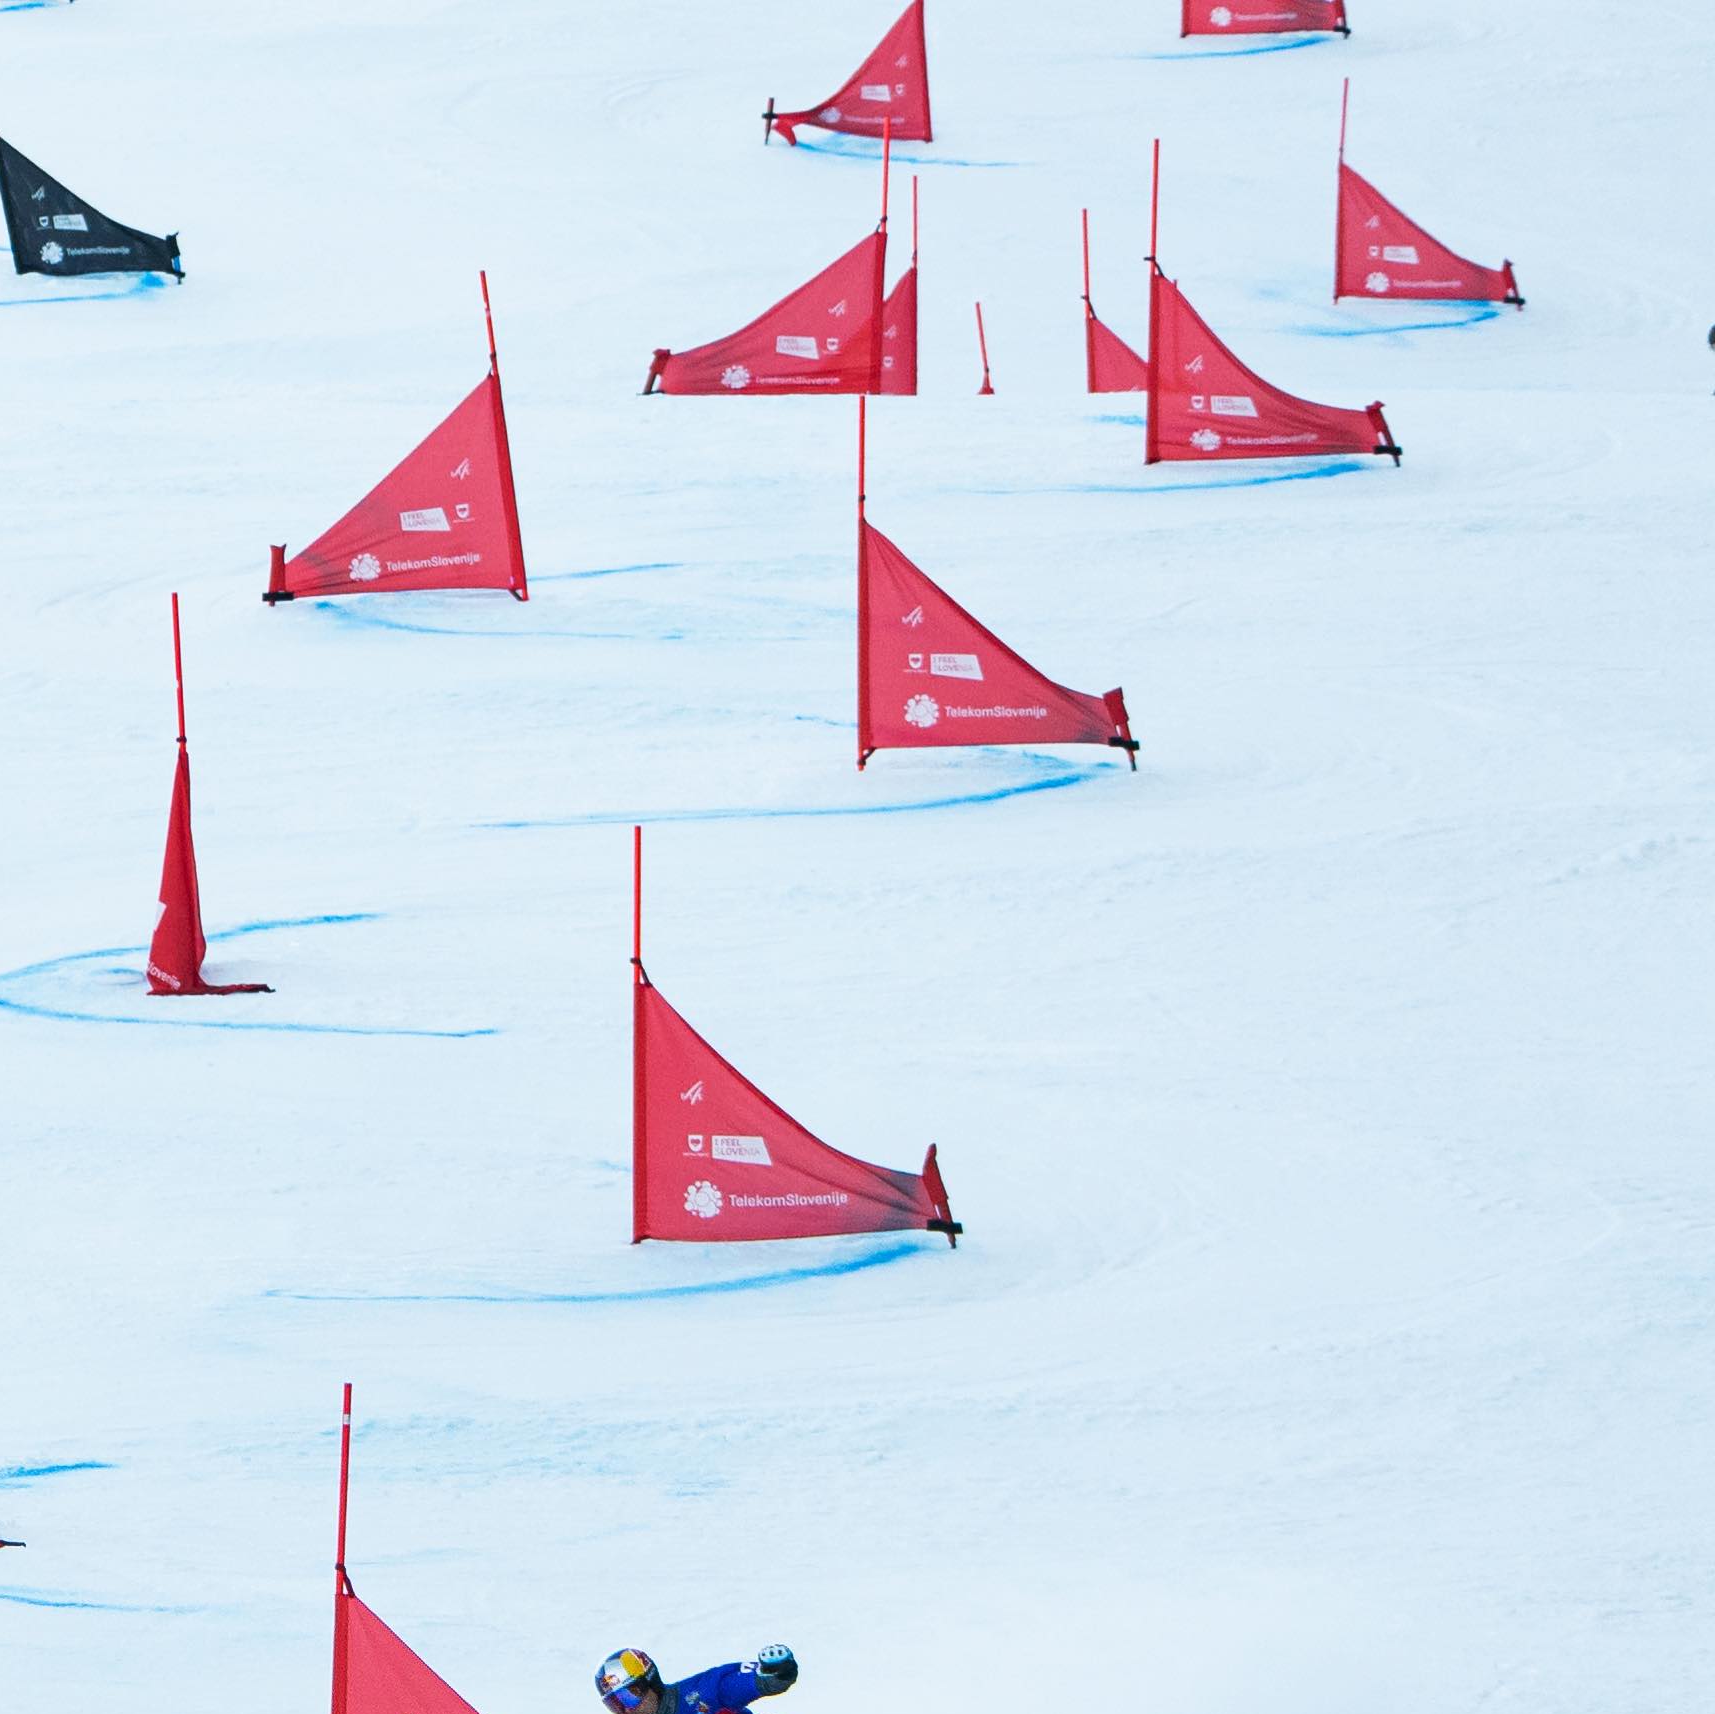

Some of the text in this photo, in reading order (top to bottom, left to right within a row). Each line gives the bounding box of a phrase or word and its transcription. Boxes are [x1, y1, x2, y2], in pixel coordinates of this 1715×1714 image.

[385, 552, 480, 573] TelekomSlovenije
[945, 704, 1048, 720] TelekomSlovenije
[728, 1193, 849, 1209] TelekomSlovenije
